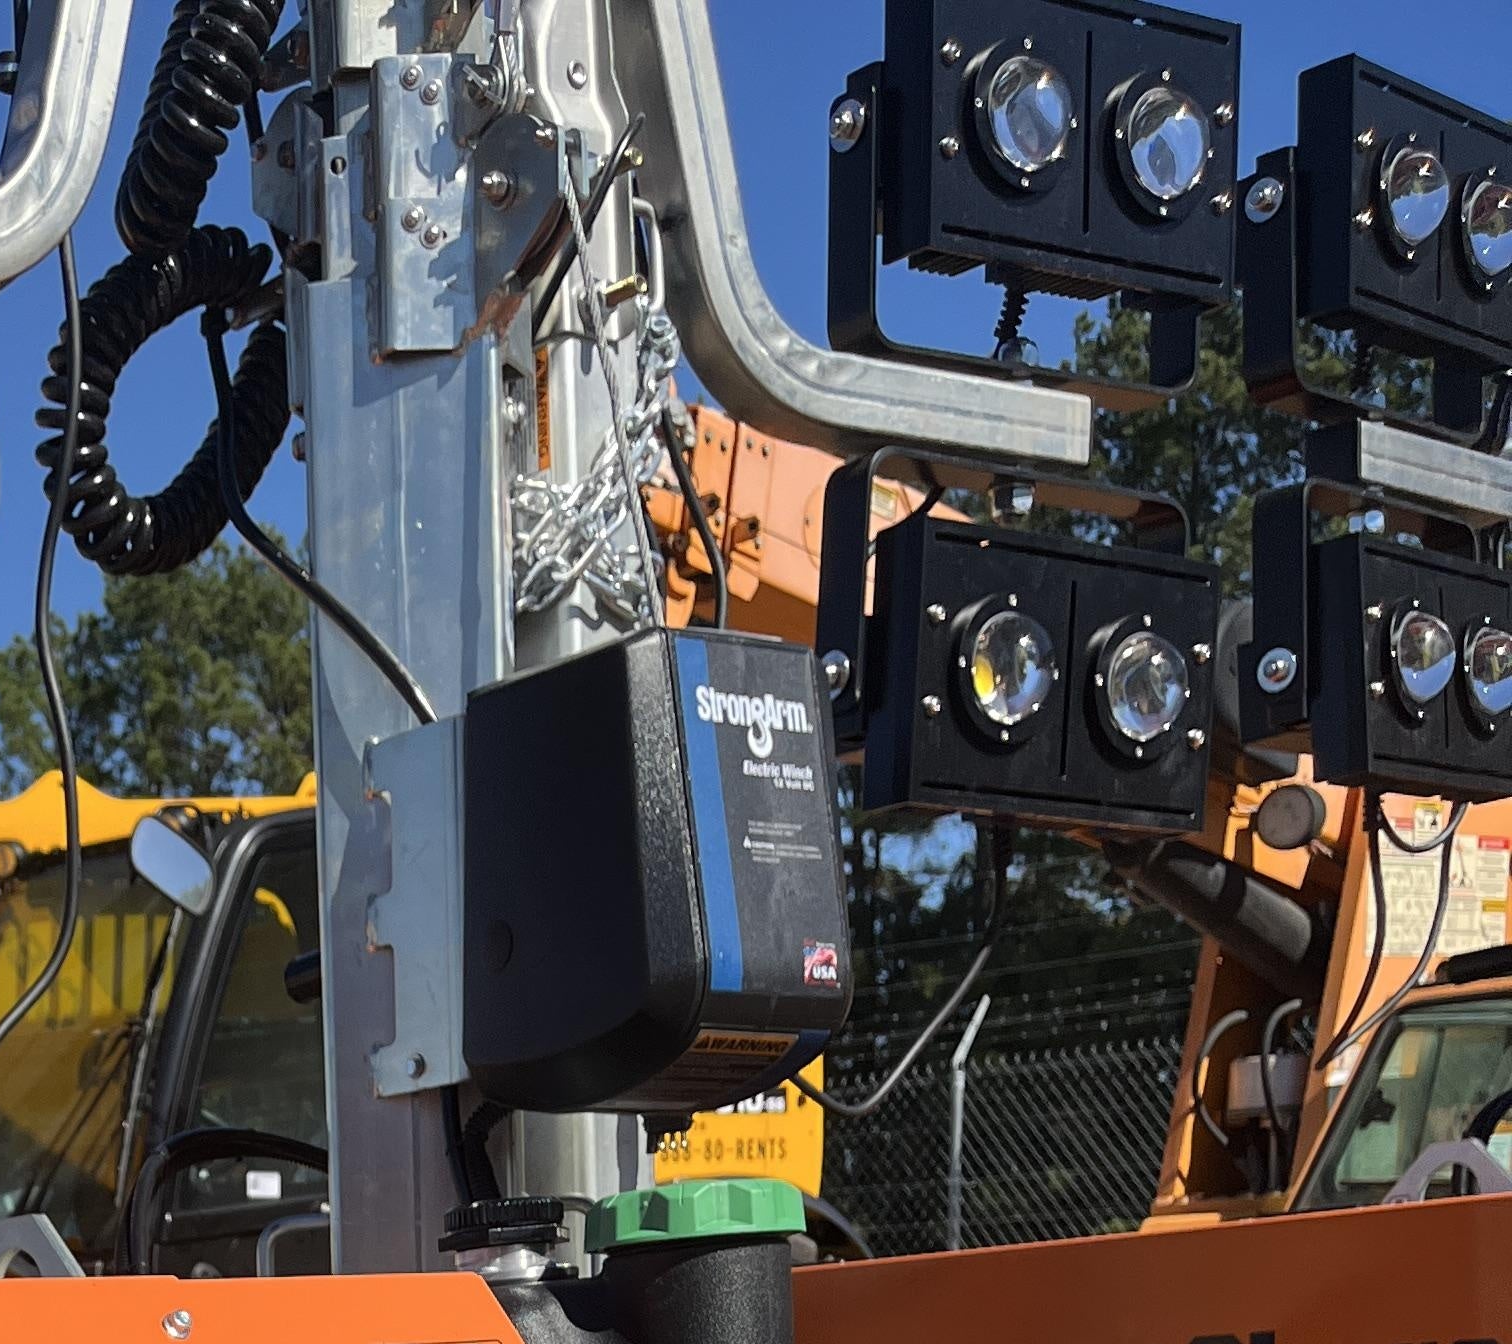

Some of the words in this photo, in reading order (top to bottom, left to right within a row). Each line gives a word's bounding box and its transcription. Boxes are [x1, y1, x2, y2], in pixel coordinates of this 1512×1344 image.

[743, 759, 780, 778] Electric
[782, 763, 813, 780] Winch
[812, 964, 837, 980] USA
[710, 1037, 789, 1053] WARNING
